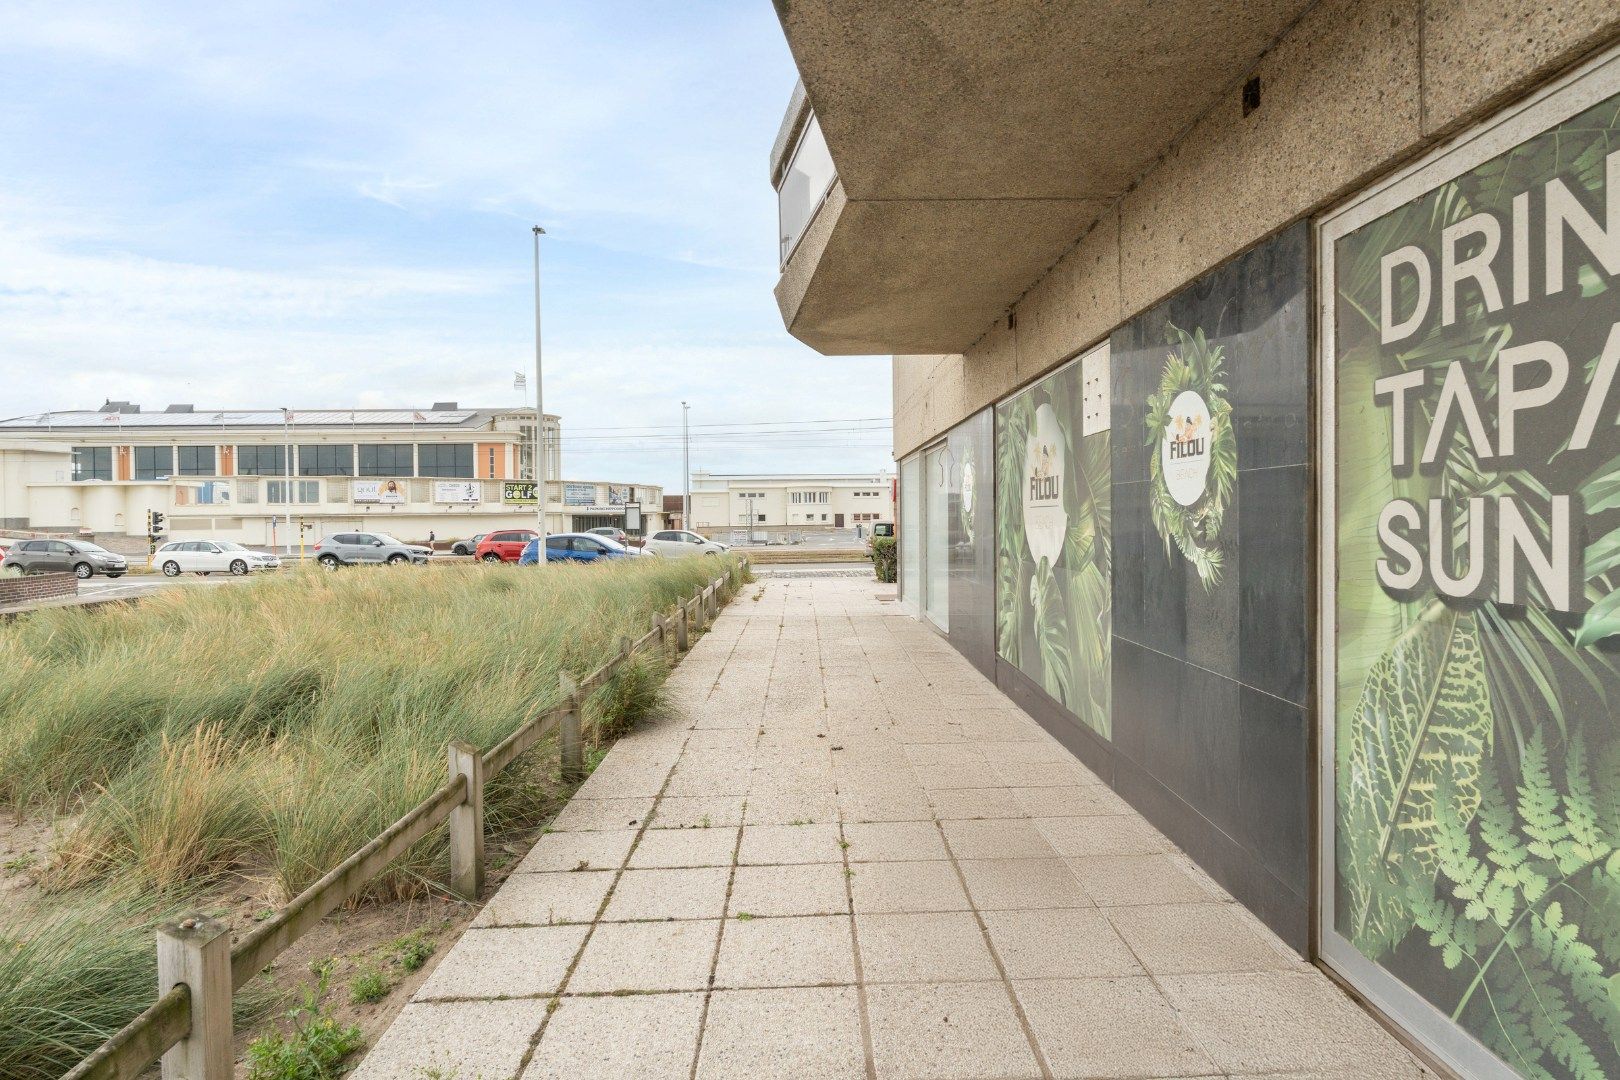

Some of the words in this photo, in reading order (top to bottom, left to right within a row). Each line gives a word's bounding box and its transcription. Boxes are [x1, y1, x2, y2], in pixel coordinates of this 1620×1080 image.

[1170, 438, 1204, 459] FILOU
[505, 490, 533, 499] GOLF
[1030, 475, 1059, 501] FILOU
[1376, 495, 1570, 612] SUN
